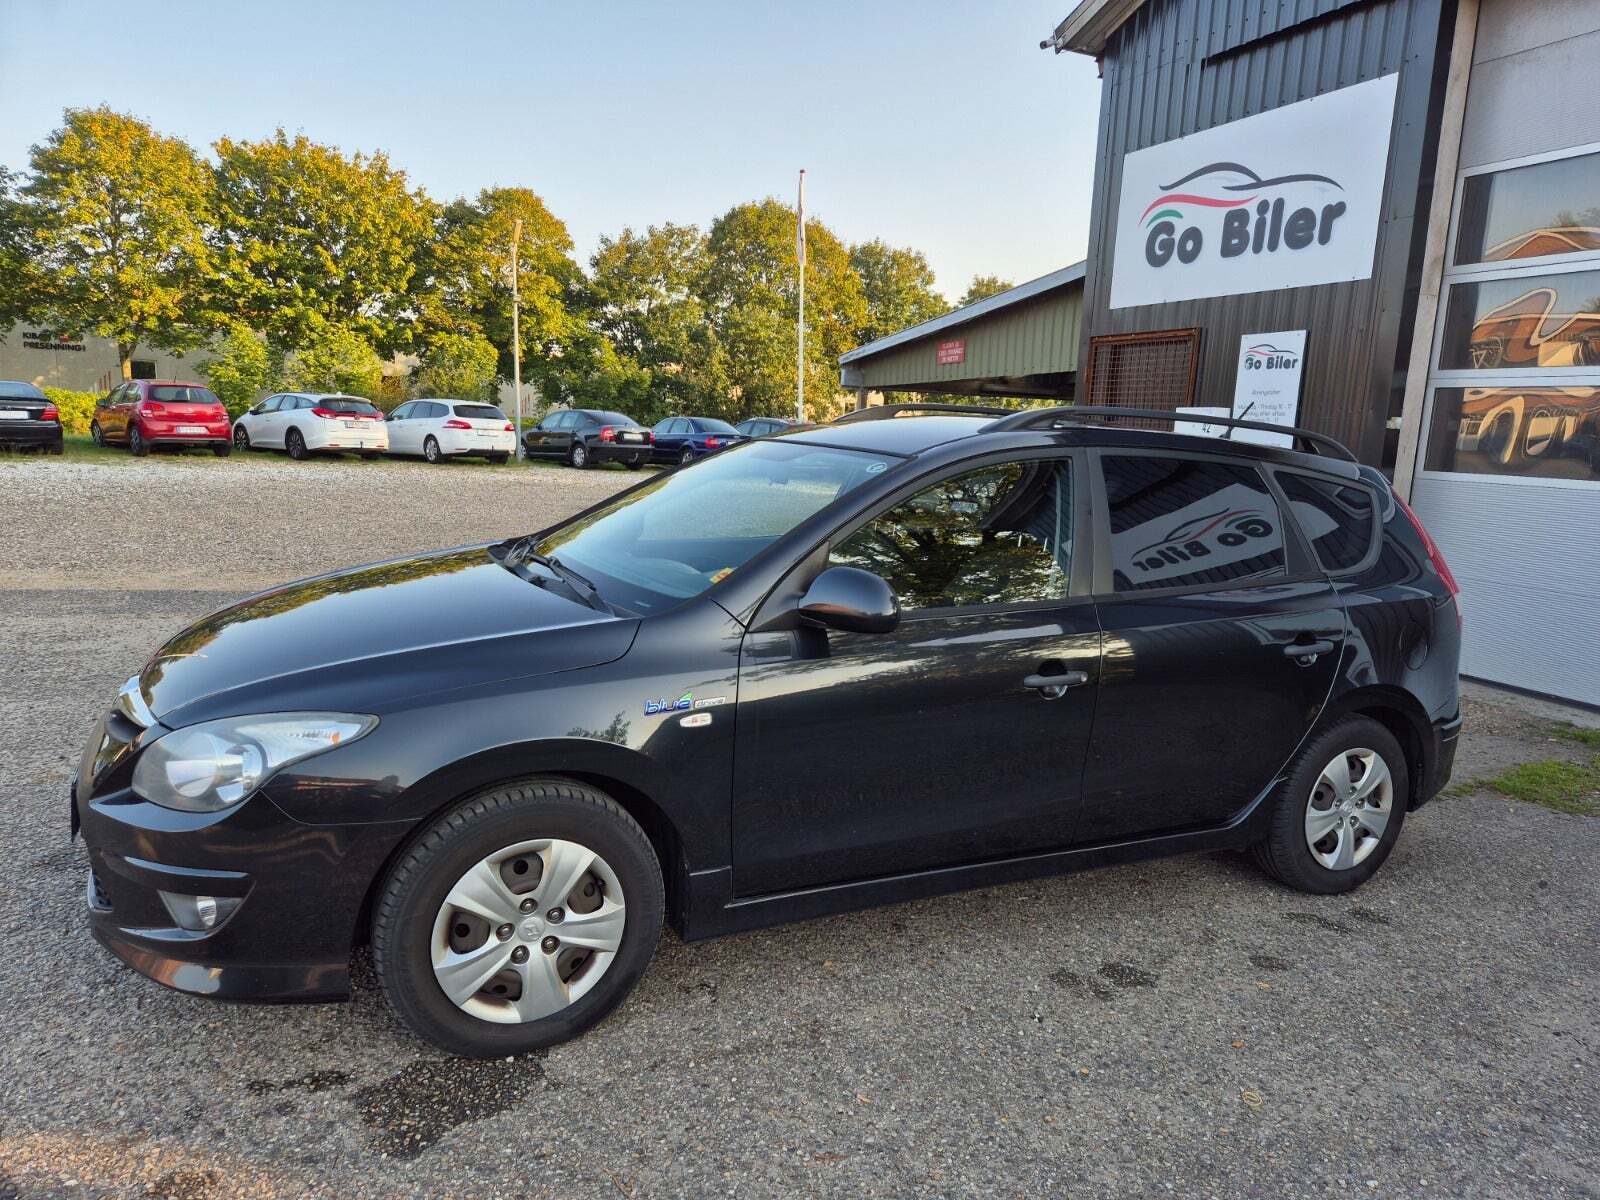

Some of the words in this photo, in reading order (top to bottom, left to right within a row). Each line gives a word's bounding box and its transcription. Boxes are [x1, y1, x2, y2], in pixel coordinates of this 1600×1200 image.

[1145, 220, 1203, 268] Go
[1220, 197, 1346, 258] Biler
[1244, 356, 1262, 370] Go
[1266, 355, 1299, 370] Biler
